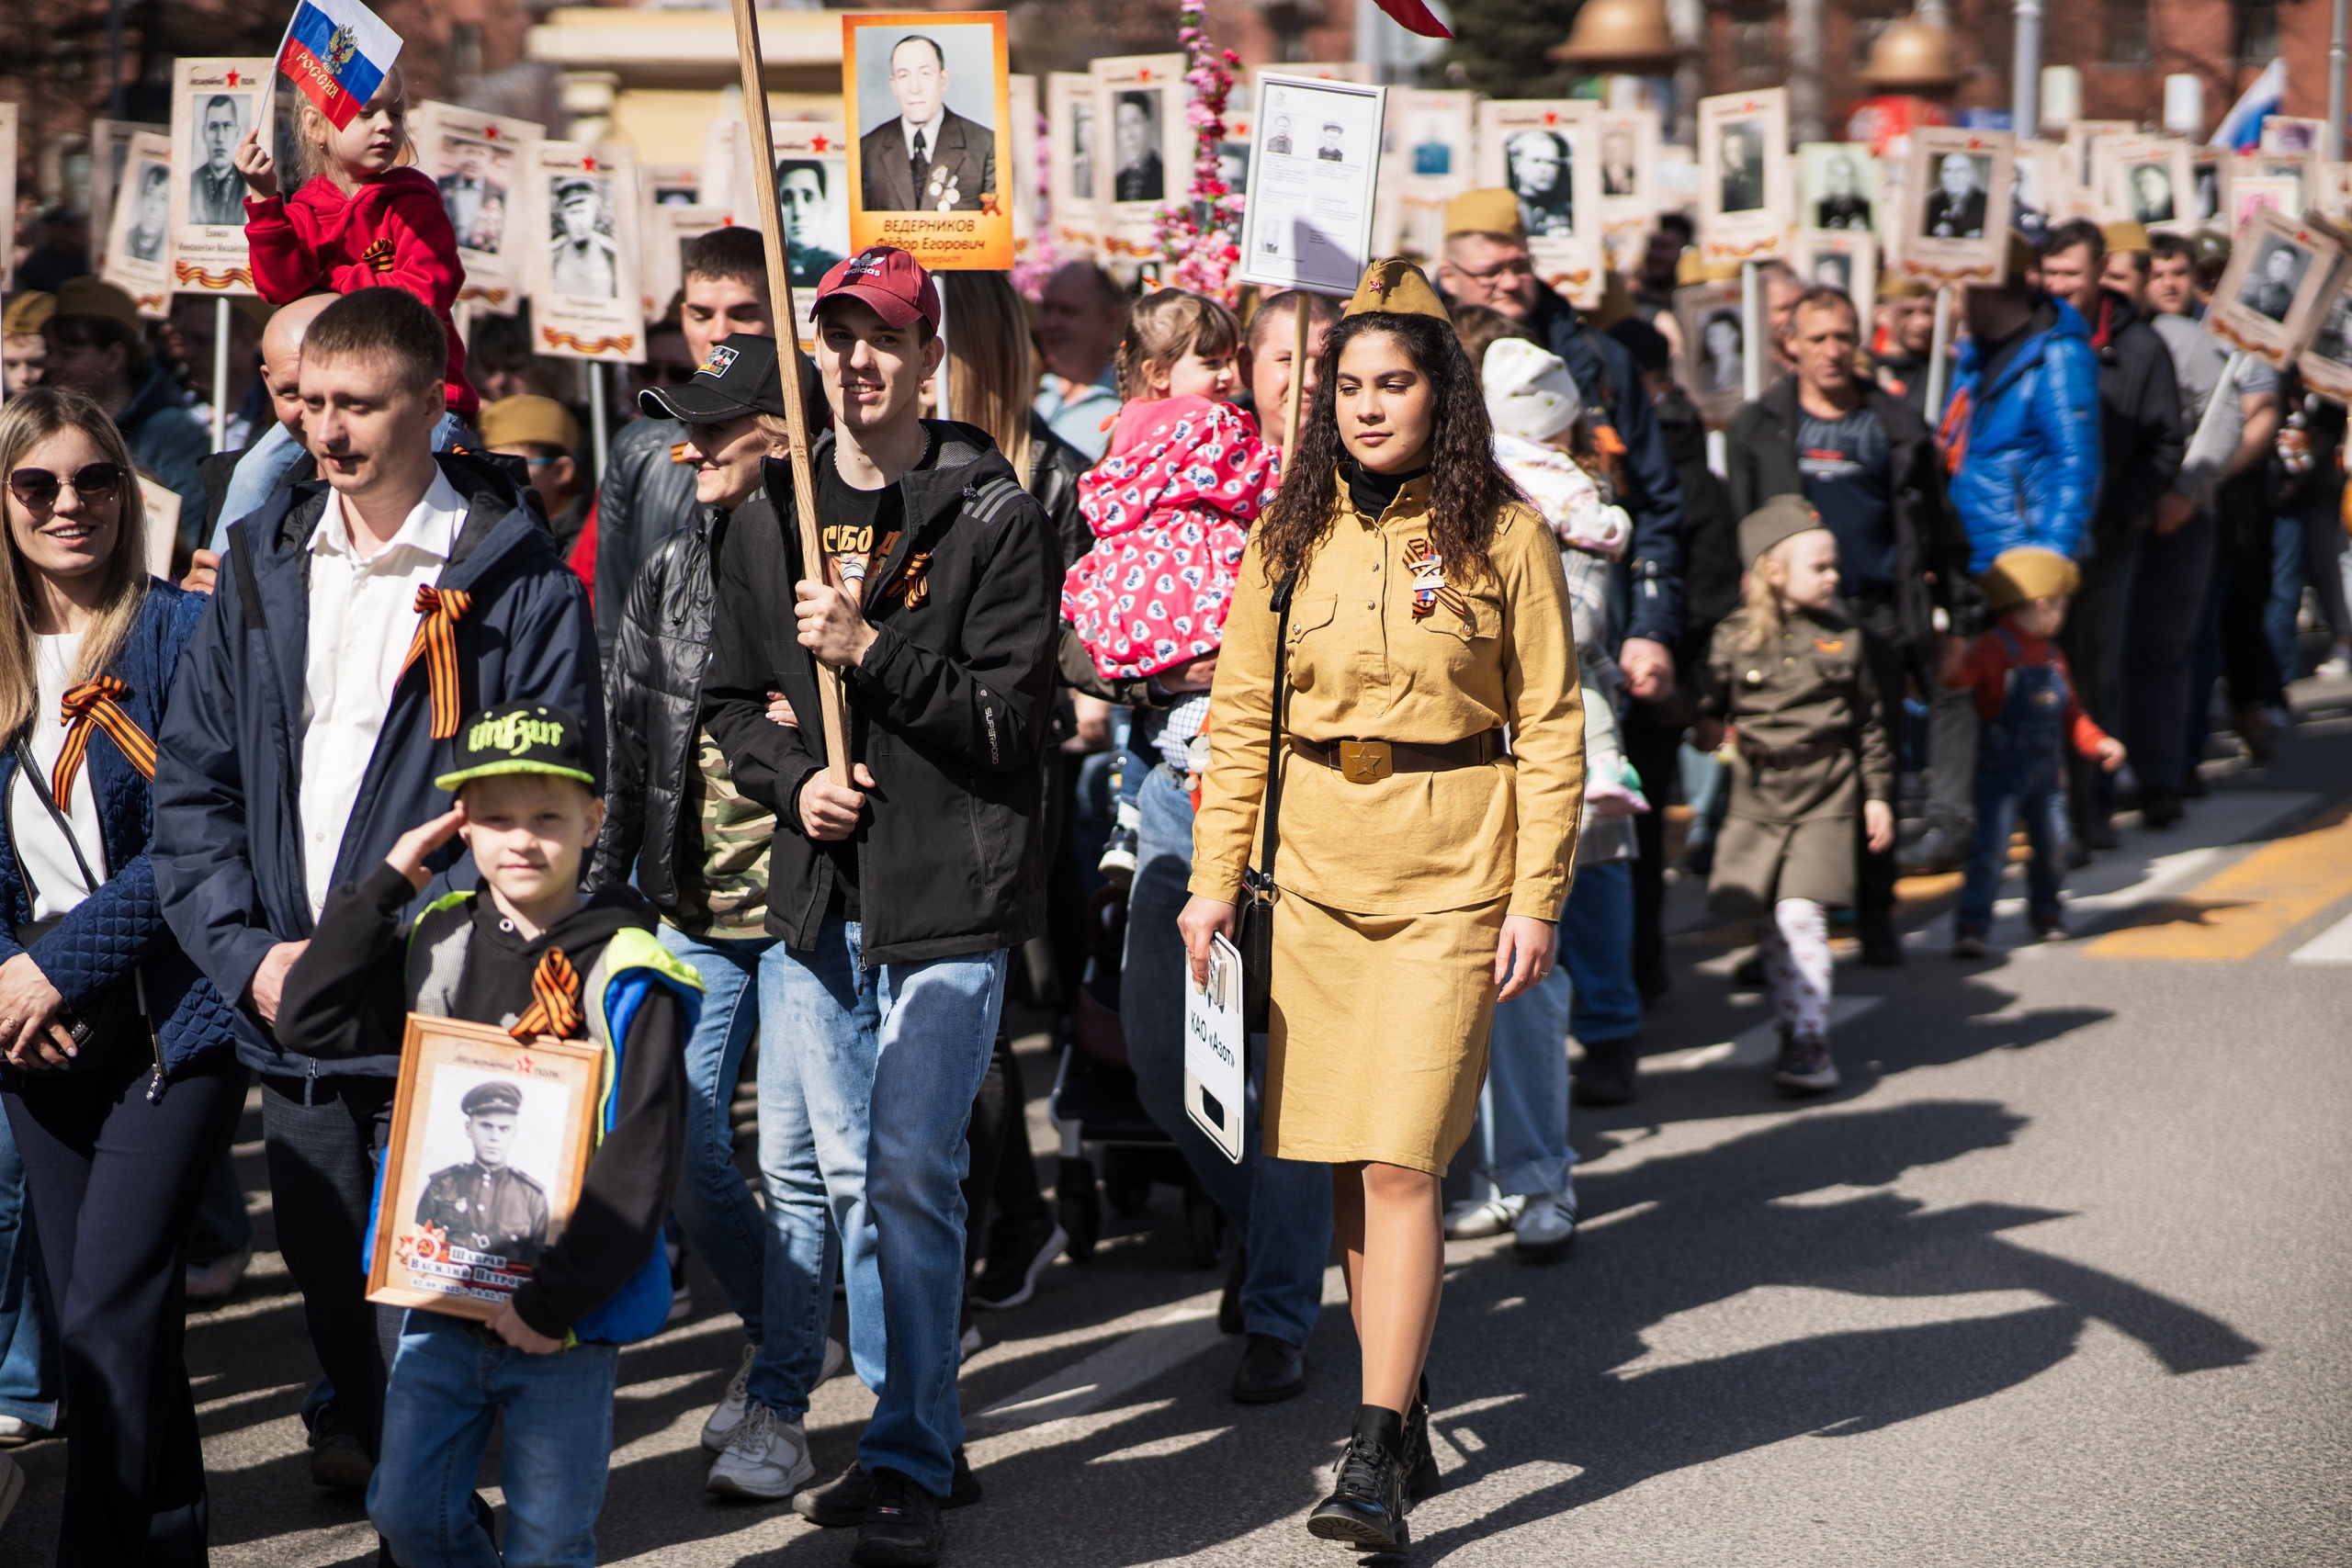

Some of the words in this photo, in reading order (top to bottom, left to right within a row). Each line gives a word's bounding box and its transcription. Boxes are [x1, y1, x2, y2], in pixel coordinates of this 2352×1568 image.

[296, 51, 340, 100] РОССИЯ
[884, 219, 976, 233] ВЕДЕРНИКОВ
[876, 237, 919, 252] Фёдор
[922, 238, 986, 253] Егорович
[842, 265, 882, 277] adidas
[1191, 1009, 1207, 1043] КАО
[1208, 1031, 1236, 1068] «Азот»
